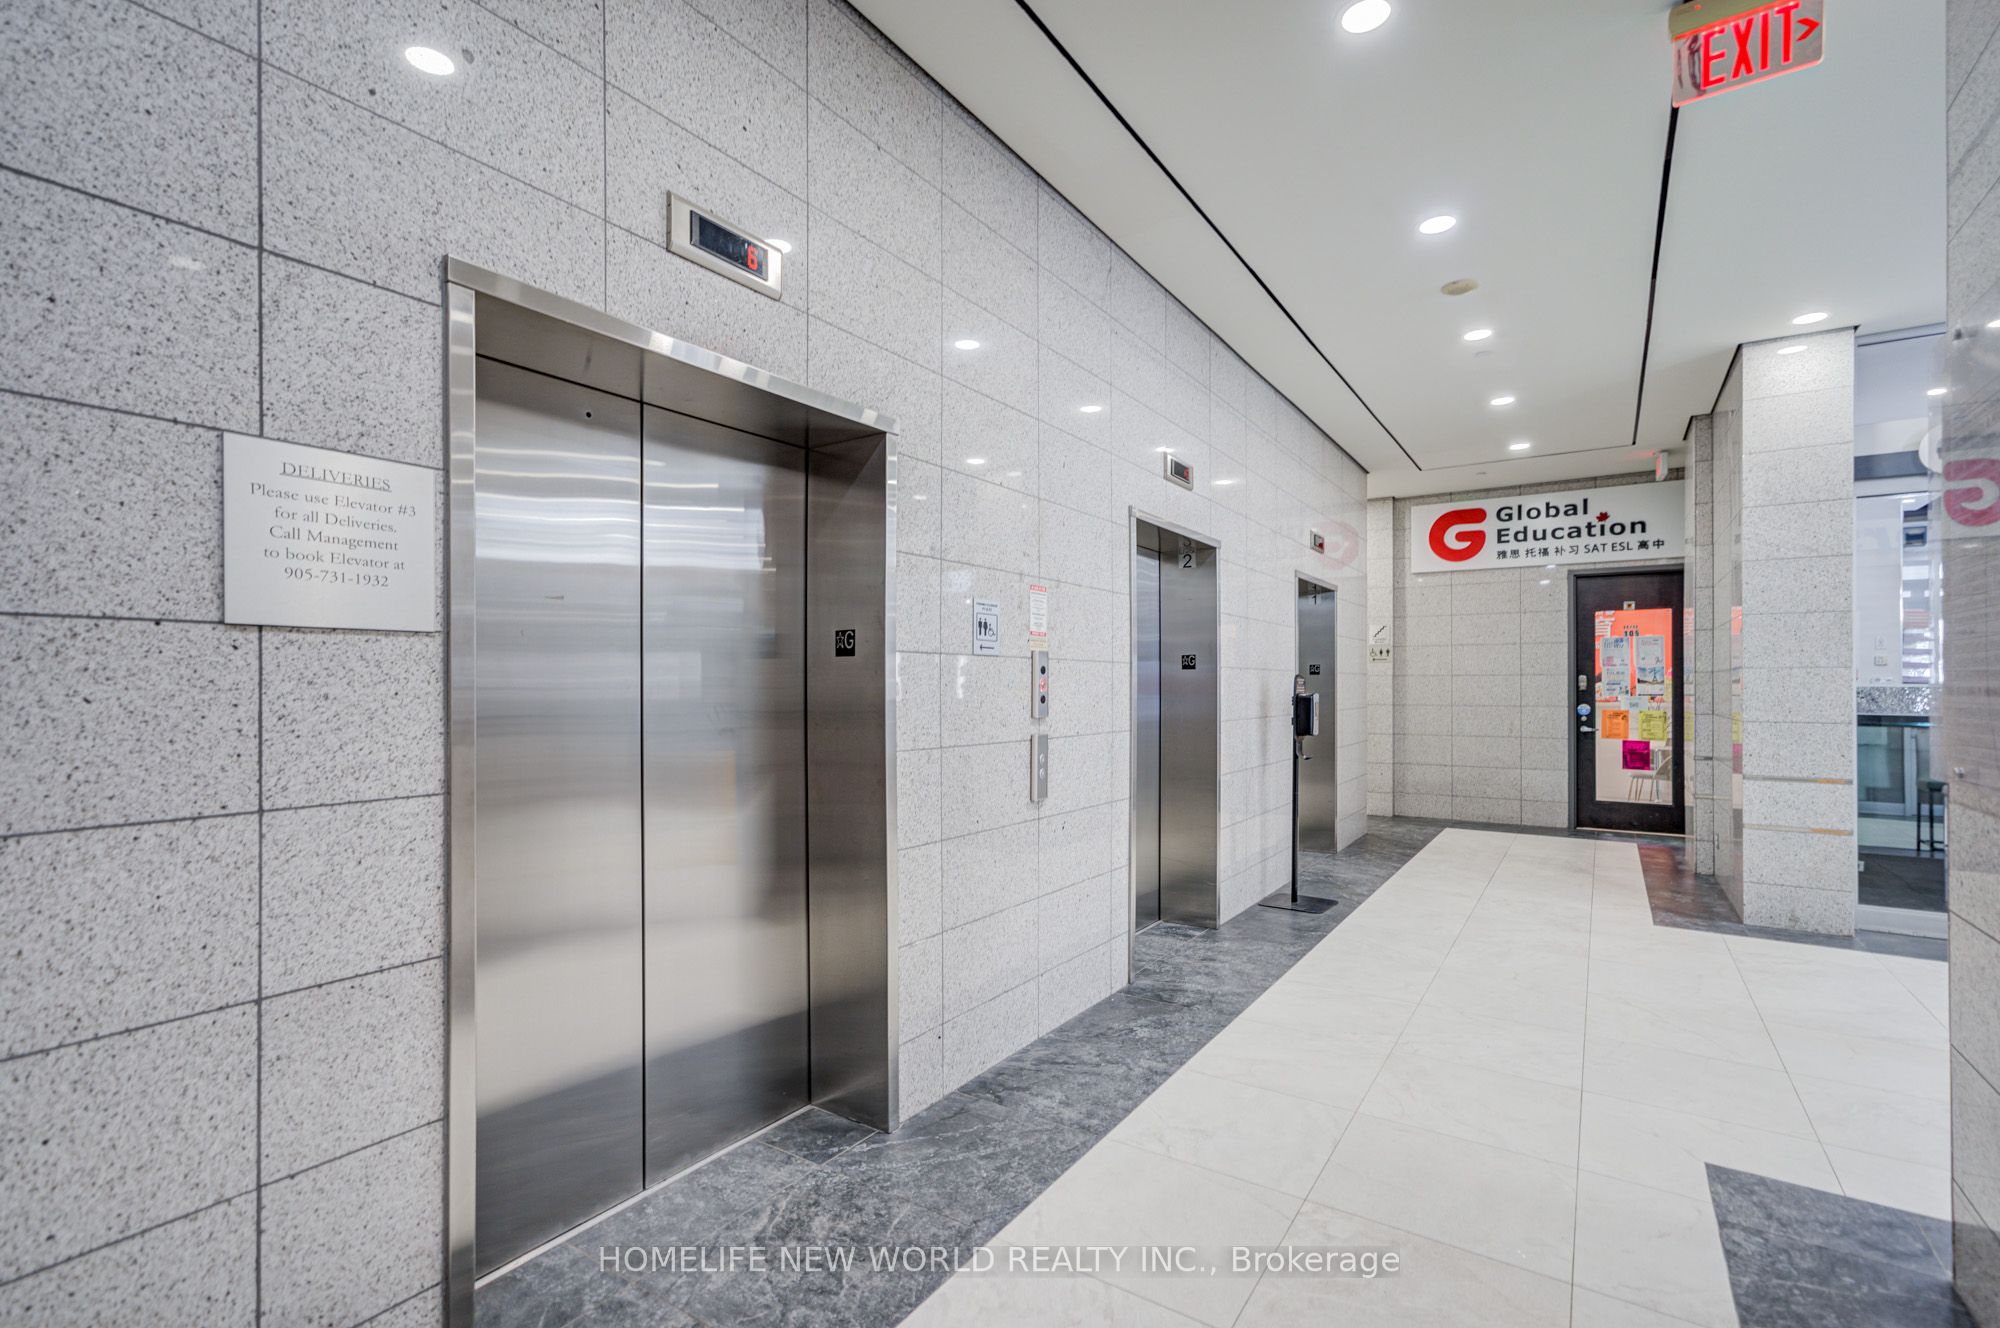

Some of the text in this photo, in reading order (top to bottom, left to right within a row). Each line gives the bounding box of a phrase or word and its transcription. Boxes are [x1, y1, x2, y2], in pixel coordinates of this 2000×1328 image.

[1701, 2, 1800, 90] EXIT
[280, 462, 392, 491] DELIVERIES
[250, 482, 416, 517] Please use Elevator #3
[1496, 498, 1589, 522] Global
[274, 506, 298, 520] for
[303, 511, 319, 523] all
[269, 525, 398, 551] Call Management
[1429, 507, 1487, 562] G
[1496, 515, 1647, 544] Education
[264, 547, 405, 570] to book Elevator at
[1583, 542, 1608, 554] SAT
[1611, 541, 1633, 552] ESL
[1183, 553, 1193, 568] 2
[284, 567, 389, 587] 905-731-1932
